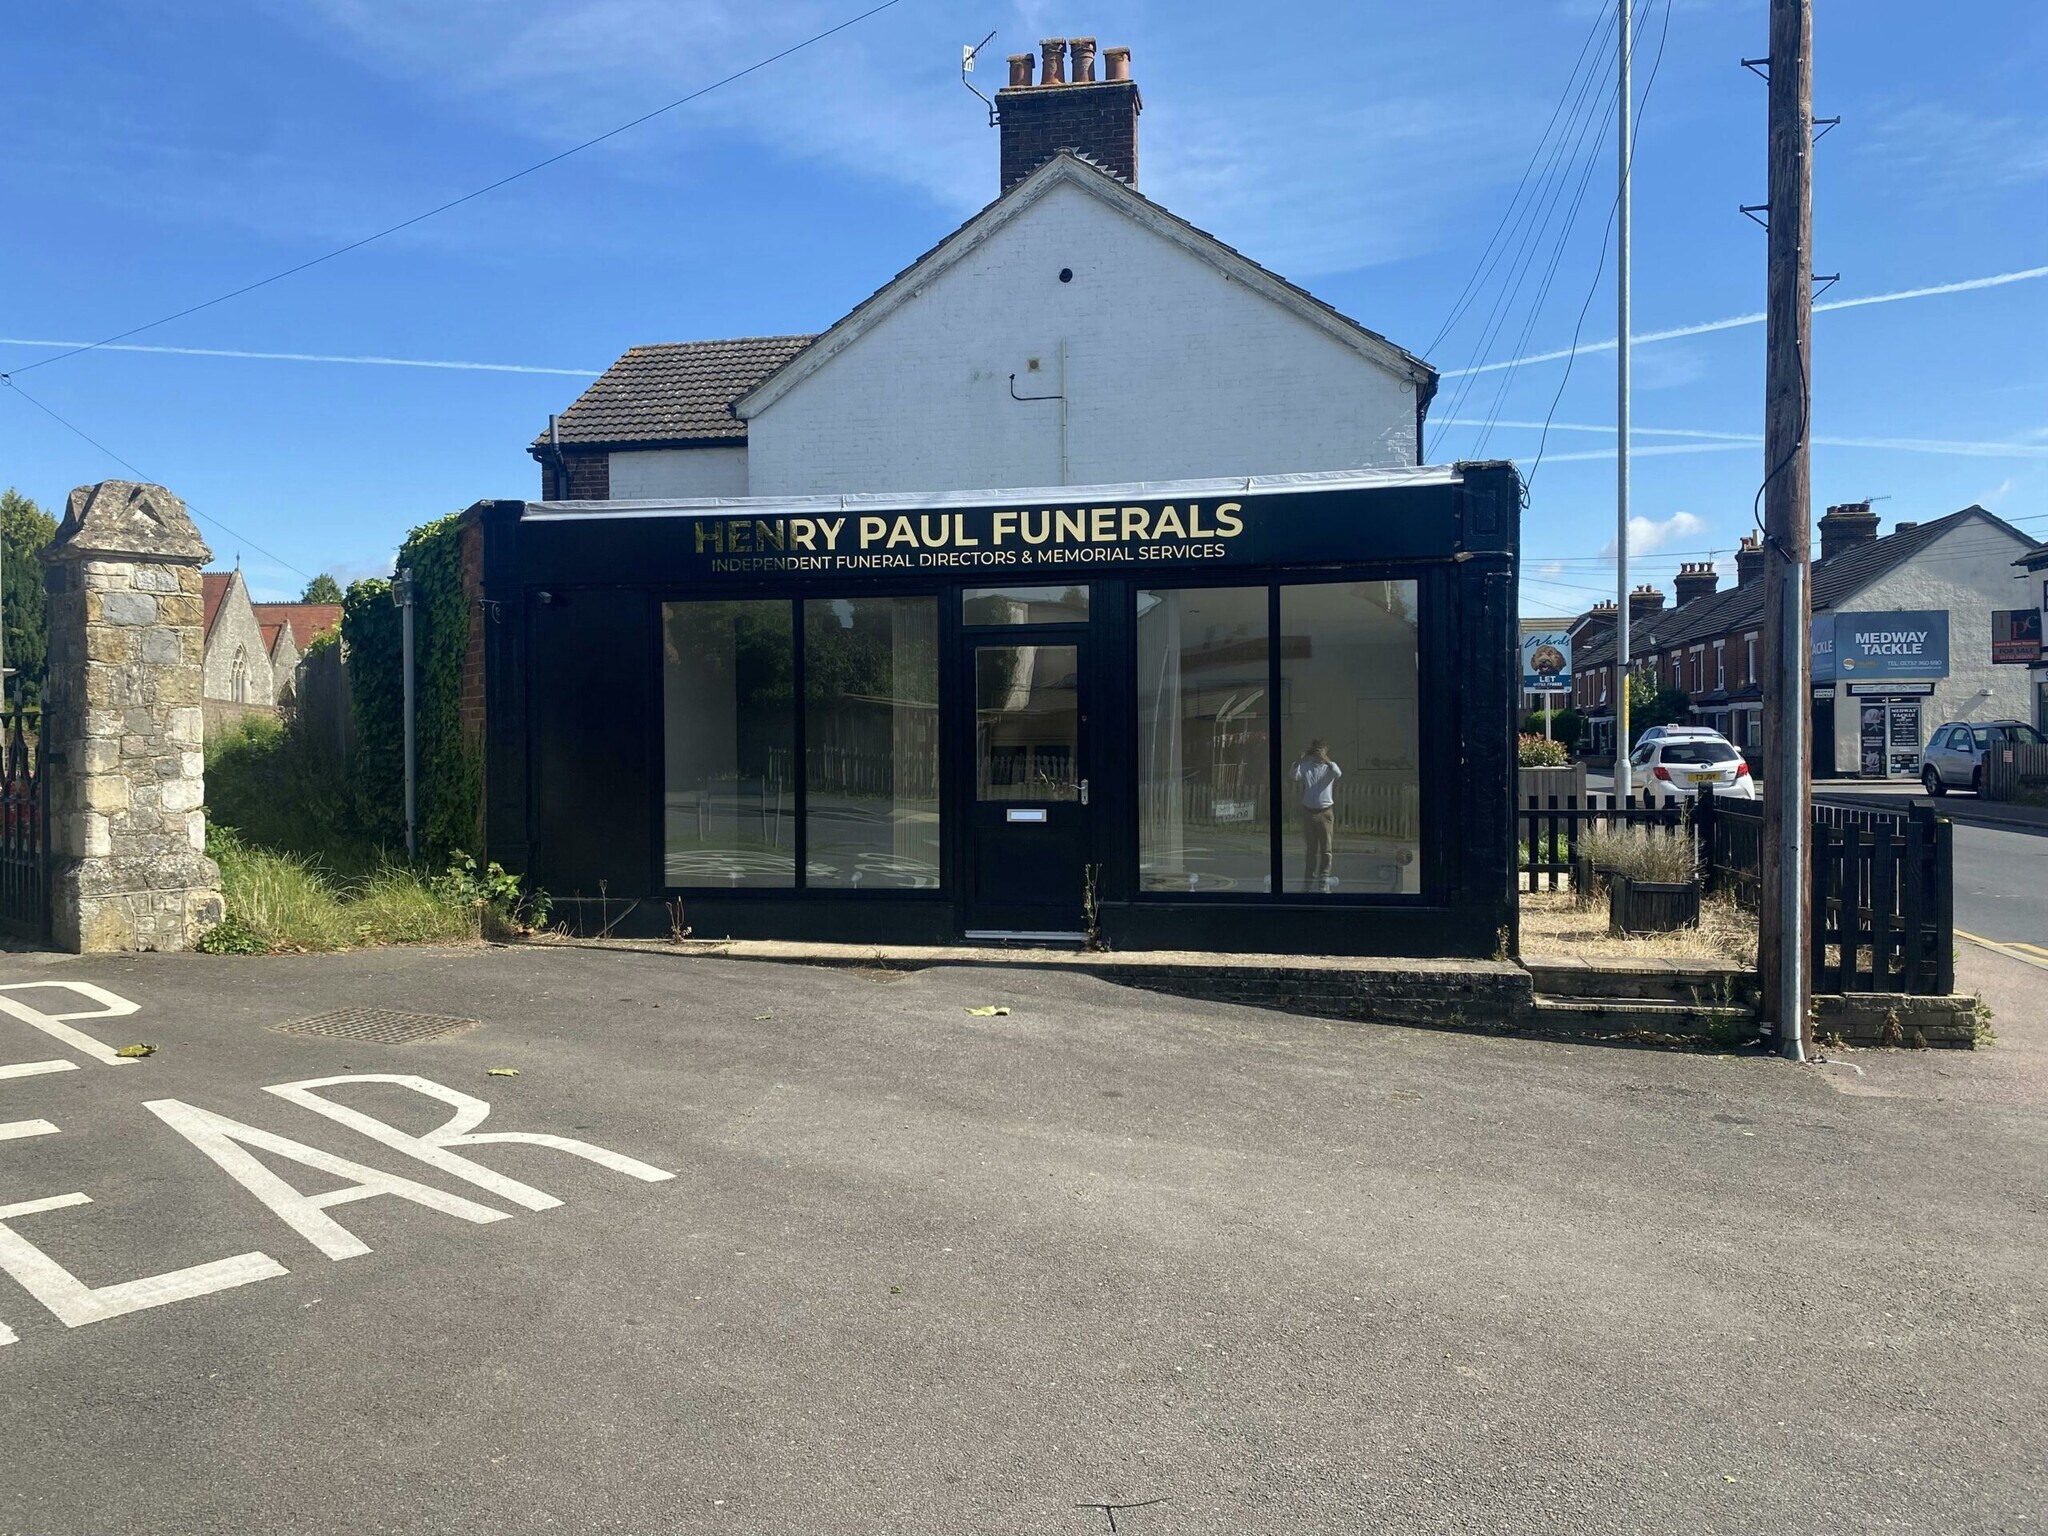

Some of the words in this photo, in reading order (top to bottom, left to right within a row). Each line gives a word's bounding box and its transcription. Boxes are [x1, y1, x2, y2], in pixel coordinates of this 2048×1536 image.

[695, 518, 846, 553] HENRY
[860, 514, 978, 549] PAUL
[993, 503, 1244, 545] FUNERALS
[713, 557, 832, 572] INDEPENDENT
[837, 554, 914, 568] FUNERAL
[920, 551, 1016, 566] DIRECTORS
[1022, 550, 1032, 563] &
[1038, 547, 1133, 562] MEMORIAL
[1139, 544, 1225, 560] SERVICES
[1524, 634, 1570, 648] Wards
[1855, 631, 1928, 644] MEDWAY
[1812, 640, 1832, 655] ACKLE
[1862, 644, 1922, 655] TACKLE
